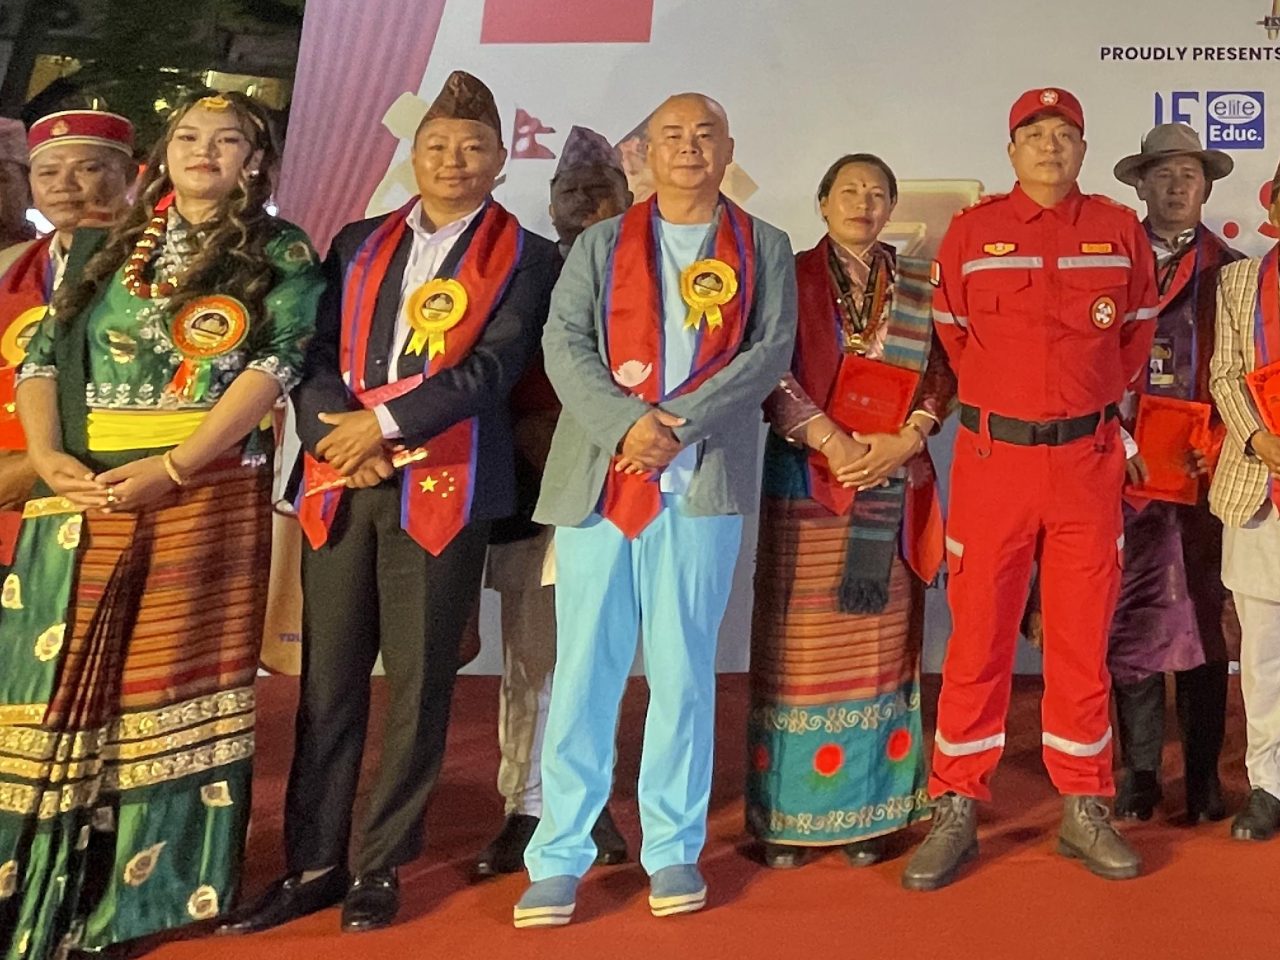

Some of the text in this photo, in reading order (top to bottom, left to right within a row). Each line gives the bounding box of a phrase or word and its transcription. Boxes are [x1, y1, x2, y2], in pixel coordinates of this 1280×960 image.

[1100, 47, 1188, 61] PROUDLY
[1214, 98, 1256, 116] elite
[1209, 125, 1263, 142] Educ.
